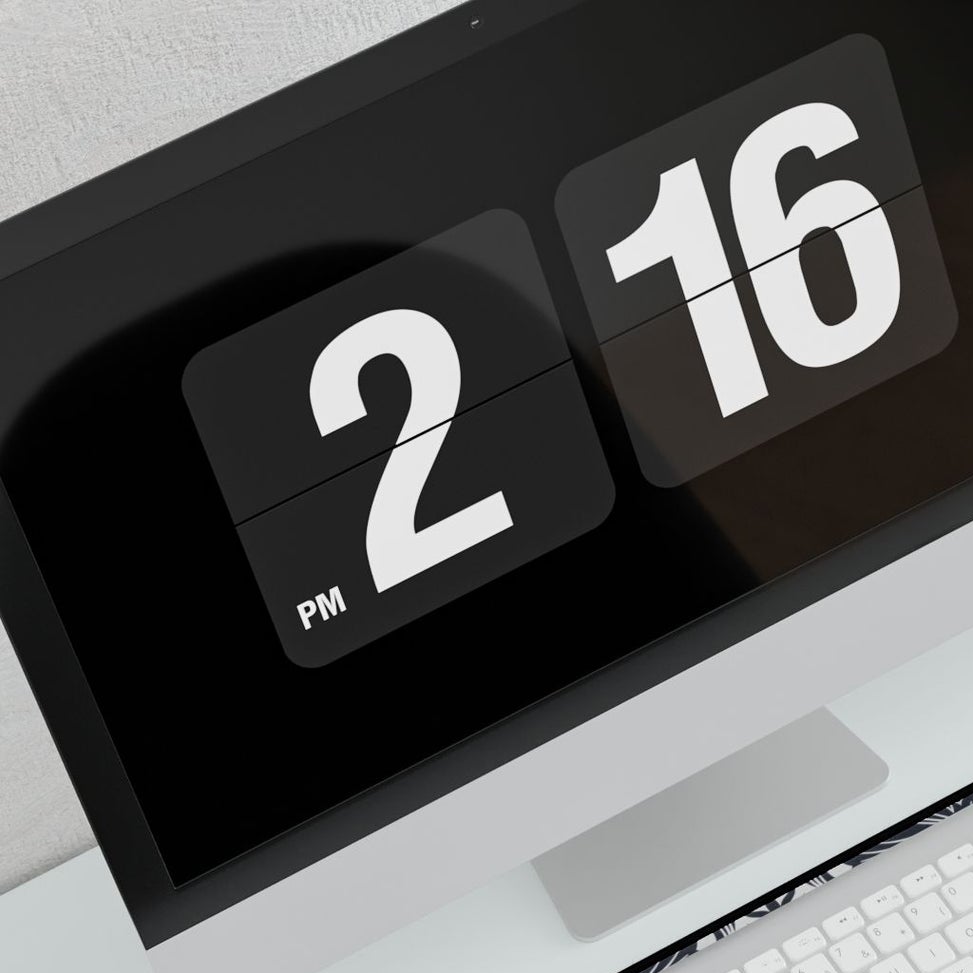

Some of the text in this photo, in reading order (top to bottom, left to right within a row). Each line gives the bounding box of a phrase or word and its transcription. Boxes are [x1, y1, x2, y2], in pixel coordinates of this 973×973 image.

[310, 103, 900, 593] 2 16
[297, 586, 346, 630] PM
[948, 887, 957, 896] 0
[910, 908, 918, 916] 9
[873, 927, 882, 936] 8
[834, 947, 842, 957] 7
[929, 949, 936, 957] I
